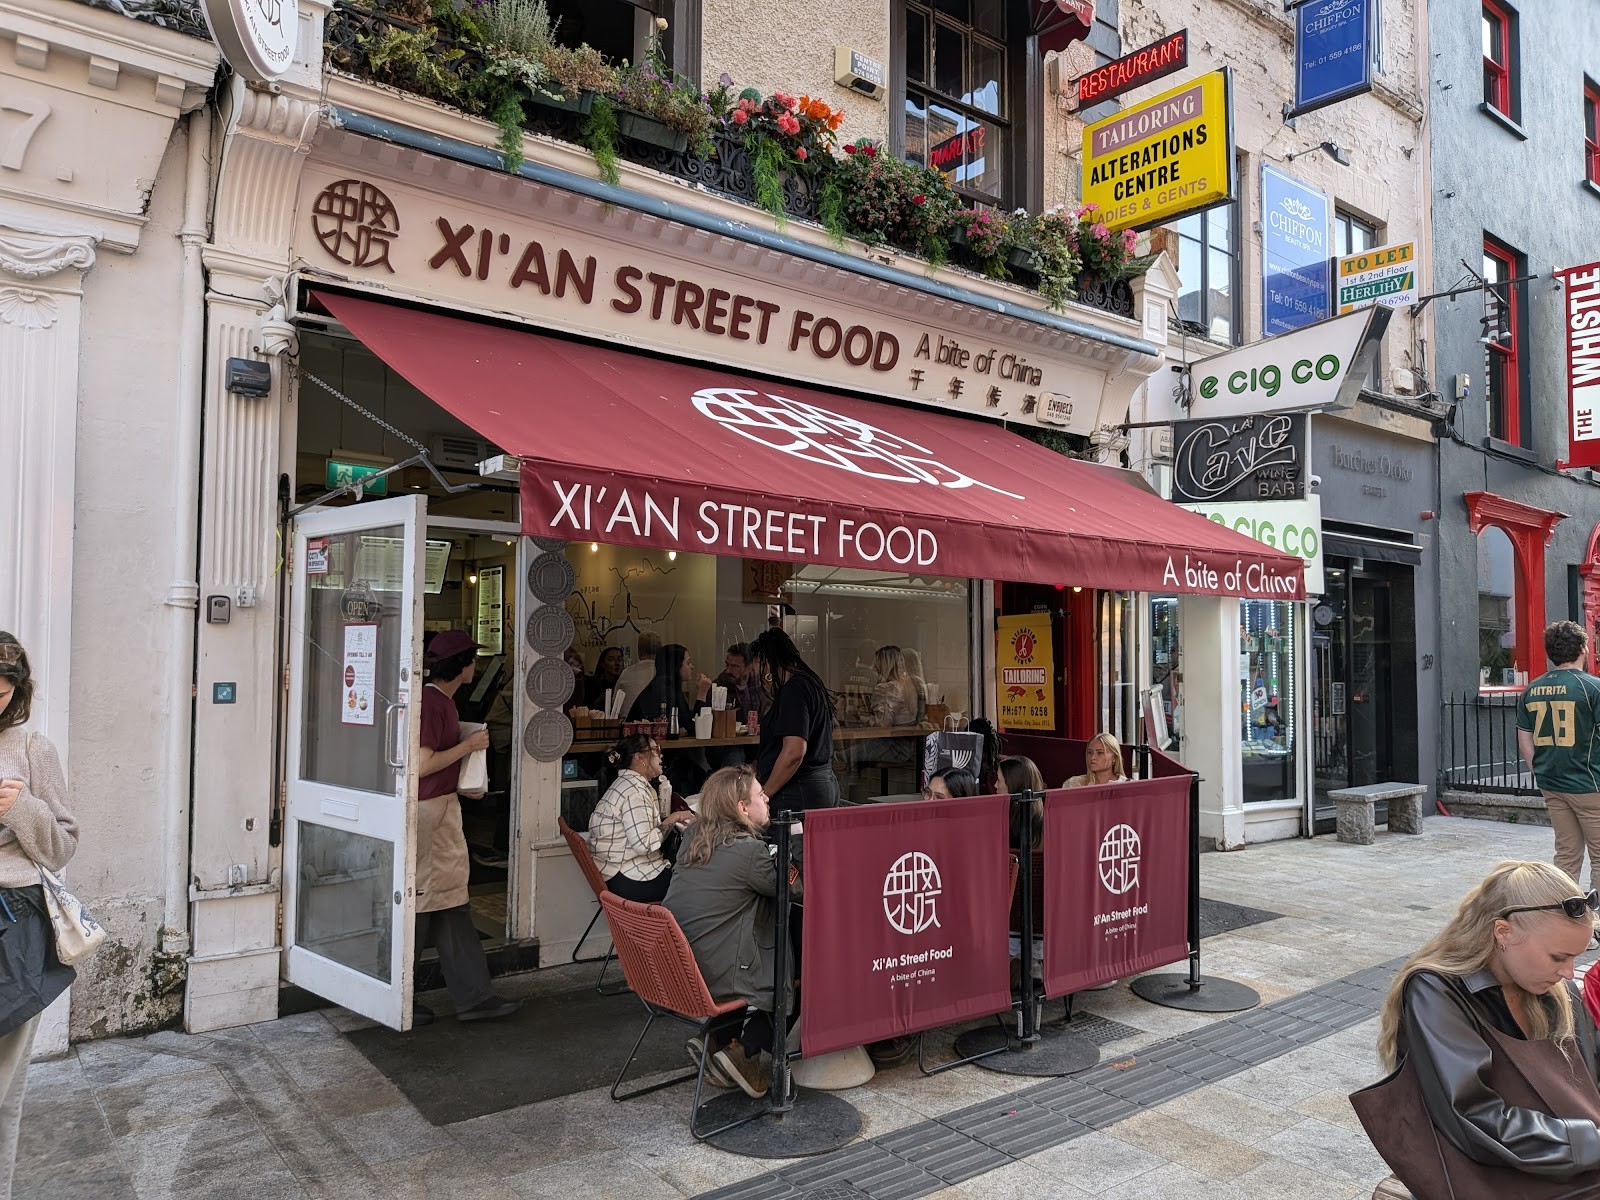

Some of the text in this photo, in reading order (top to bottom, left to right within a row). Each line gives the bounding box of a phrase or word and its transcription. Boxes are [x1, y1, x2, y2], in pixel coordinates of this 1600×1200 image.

[1305, 4, 1361, 34] CHIFFON
[1320, 20, 1348, 34] BEAUTY SPA
[257, 33, 278, 63] STREET
[276, 45, 291, 64] FOOD
[854, 52, 883, 71] CENTRE
[1304, 42, 1362, 70] Tel: 01 559 4186
[857, 60, 880, 76] POINT
[1078, 35, 1183, 100] RESTAURANT
[1098, 95, 1195, 149] TAILORING
[1090, 123, 1208, 187] ALTERATIONS
[1114, 160, 1180, 202] CENTRE
[1097, 177, 1208, 226] ADIES & GENTS
[1269, 210, 1323, 248] CHIFFON
[1284, 235, 1312, 252] BEAUTY SPA
[1344, 245, 1410, 274] TO LET
[1268, 261, 1325, 291] www.chiffonbeautyspa.ie
[1342, 276, 1404, 302] HERLIHY
[1345, 277, 1357, 286] 1st
[1359, 274, 1366, 282] &
[1367, 269, 1384, 281] 2nd
[1386, 265, 1409, 276] Floor
[428, 216, 597, 305] XI'AN
[610, 264, 781, 345] STREET
[787, 309, 900, 372] FOOD
[1270, 290, 1325, 320] Tel: 01 559 4186
[1388, 293, 1410, 305] 6796
[913, 332, 1043, 387] A bite of China
[1570, 266, 1600, 438] THE WHISTLE
[1200, 354, 1341, 399] e cig co
[1256, 466, 1297, 480] WINE
[1331, 444, 1415, 482] Butcher Otoko
[1258, 481, 1296, 498] BAR
[550, 480, 939, 567] XI'AN STREET FOOD
[1282, 523, 1319, 559] CO
[1163, 555, 1298, 594] A bite of China
[347, 600, 370, 616] OPEN
[1003, 669, 1046, 684] TAILORING
[1529, 685, 1568, 697] MITRITA
[1030, 706, 1048, 717] 6258
[1525, 700, 1576, 748] 28
[1093, 902, 1148, 927] Xi'An Street Food
[1104, 928, 1109, 936] A
[1109, 926, 1119, 934] bite
[1118, 924, 1124, 932] of
[872, 945, 953, 972] Xi'An Street Food
[890, 968, 936, 983] A bite of China
